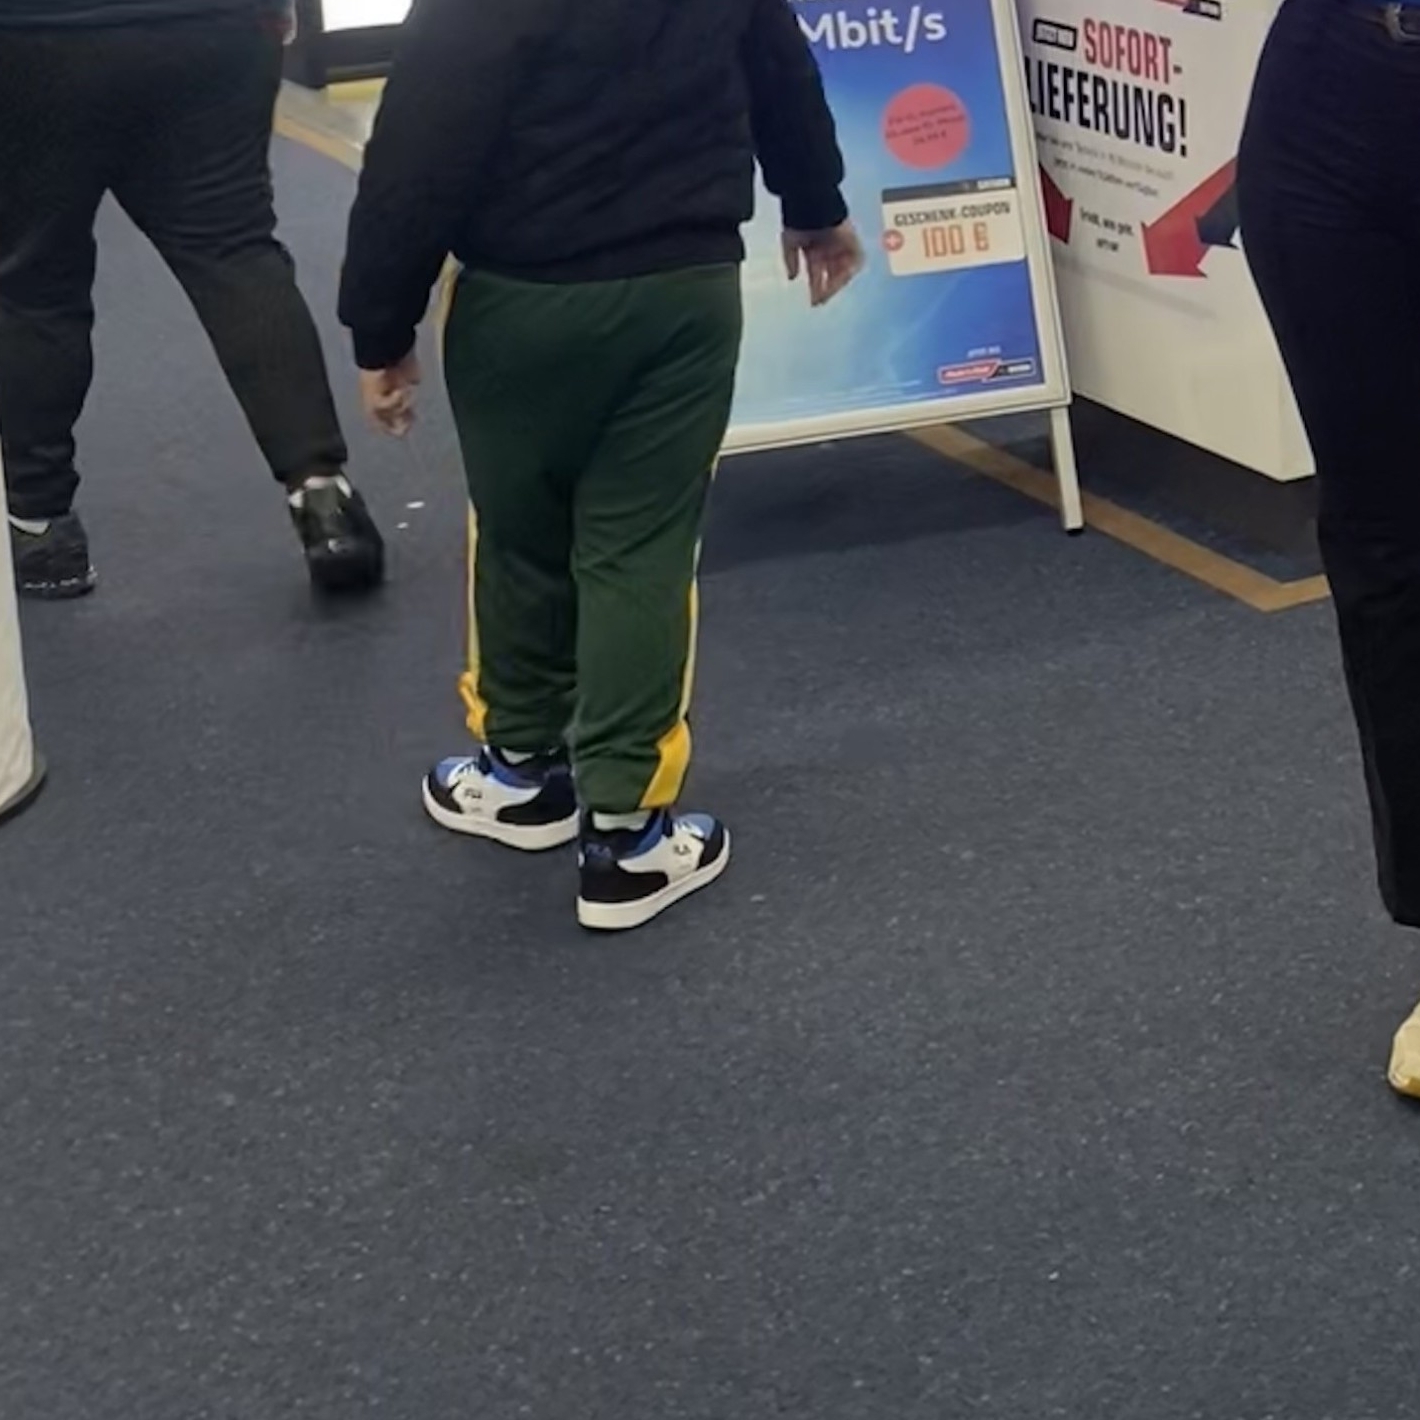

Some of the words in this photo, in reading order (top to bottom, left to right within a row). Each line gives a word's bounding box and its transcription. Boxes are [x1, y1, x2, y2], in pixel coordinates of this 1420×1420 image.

[796, 4, 948, 54] Mbit/s
[1083, 18, 1183, 85] SOFORT-
[1024, 55, 1187, 158] LIEFERUNG!
[922, 224, 966, 258] 100
